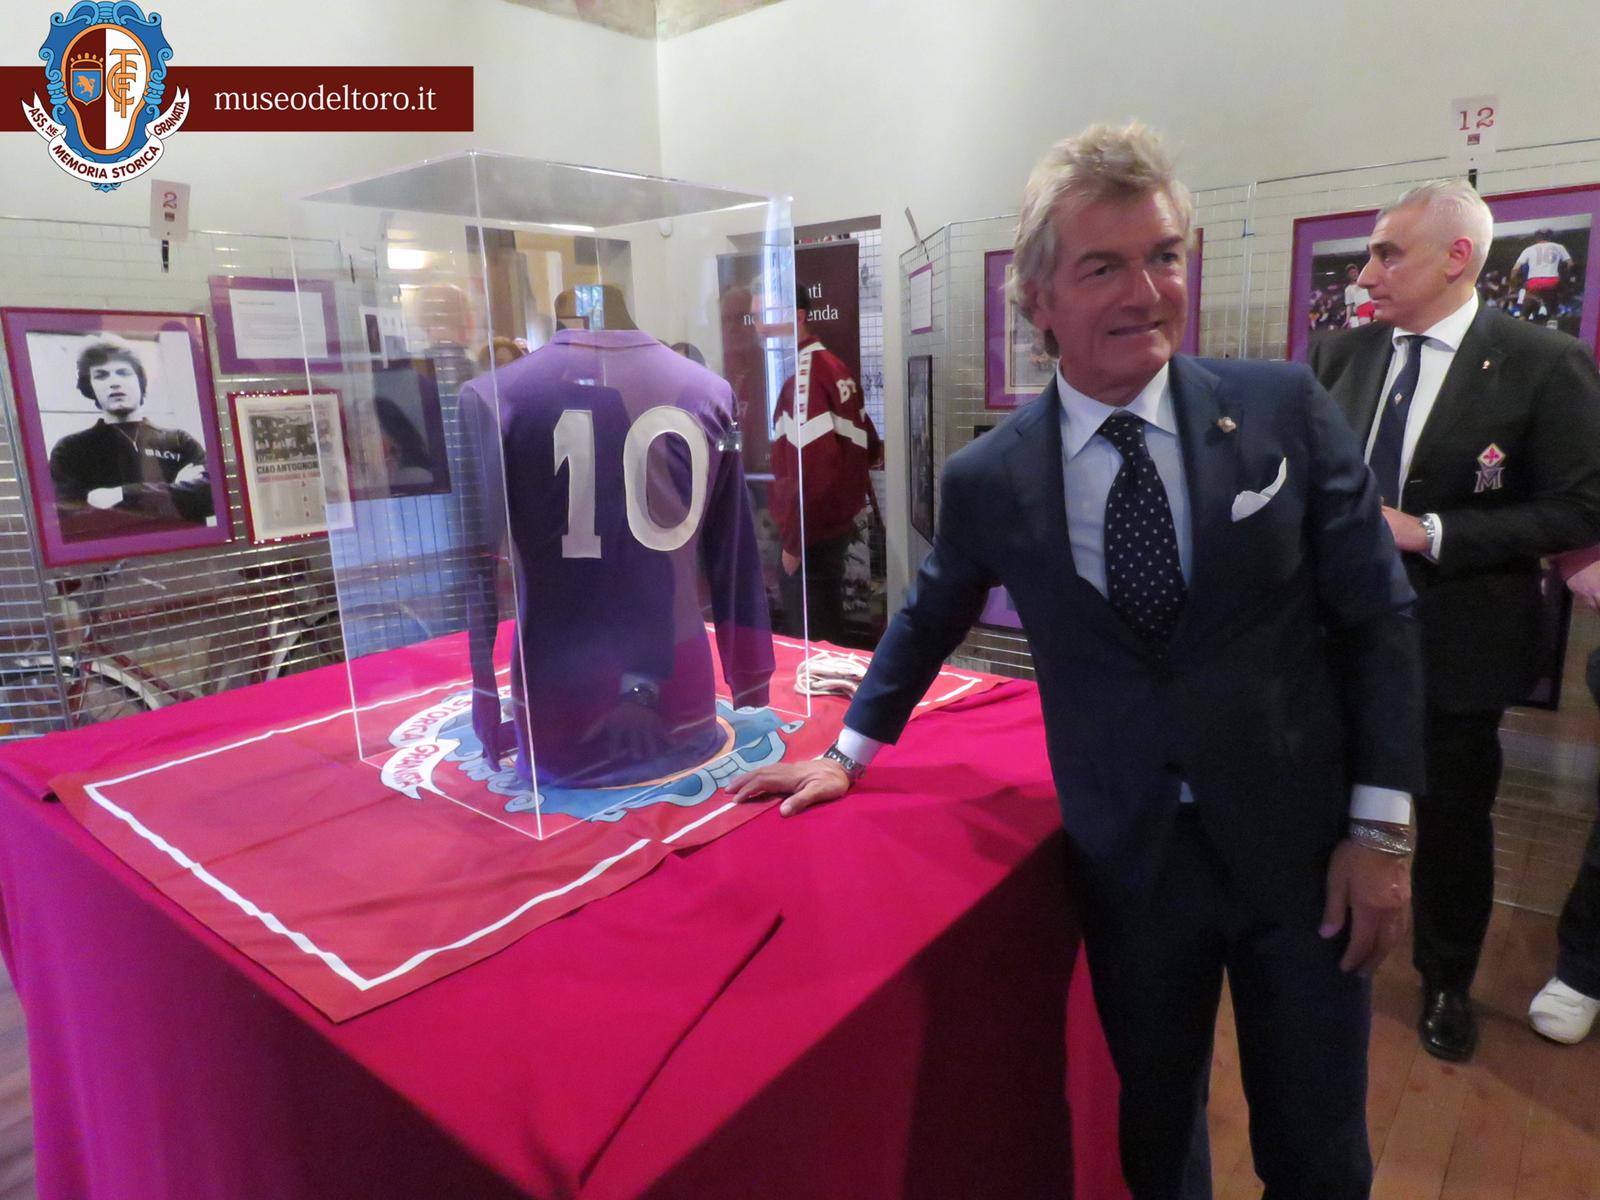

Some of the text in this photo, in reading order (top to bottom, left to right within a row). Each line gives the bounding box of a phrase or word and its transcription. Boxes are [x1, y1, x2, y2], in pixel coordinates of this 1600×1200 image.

[1459, 106, 1495, 131] 12
[162, 191, 178, 209] 2
[256, 464, 275, 475] CIAO
[553, 405, 709, 559] 10
